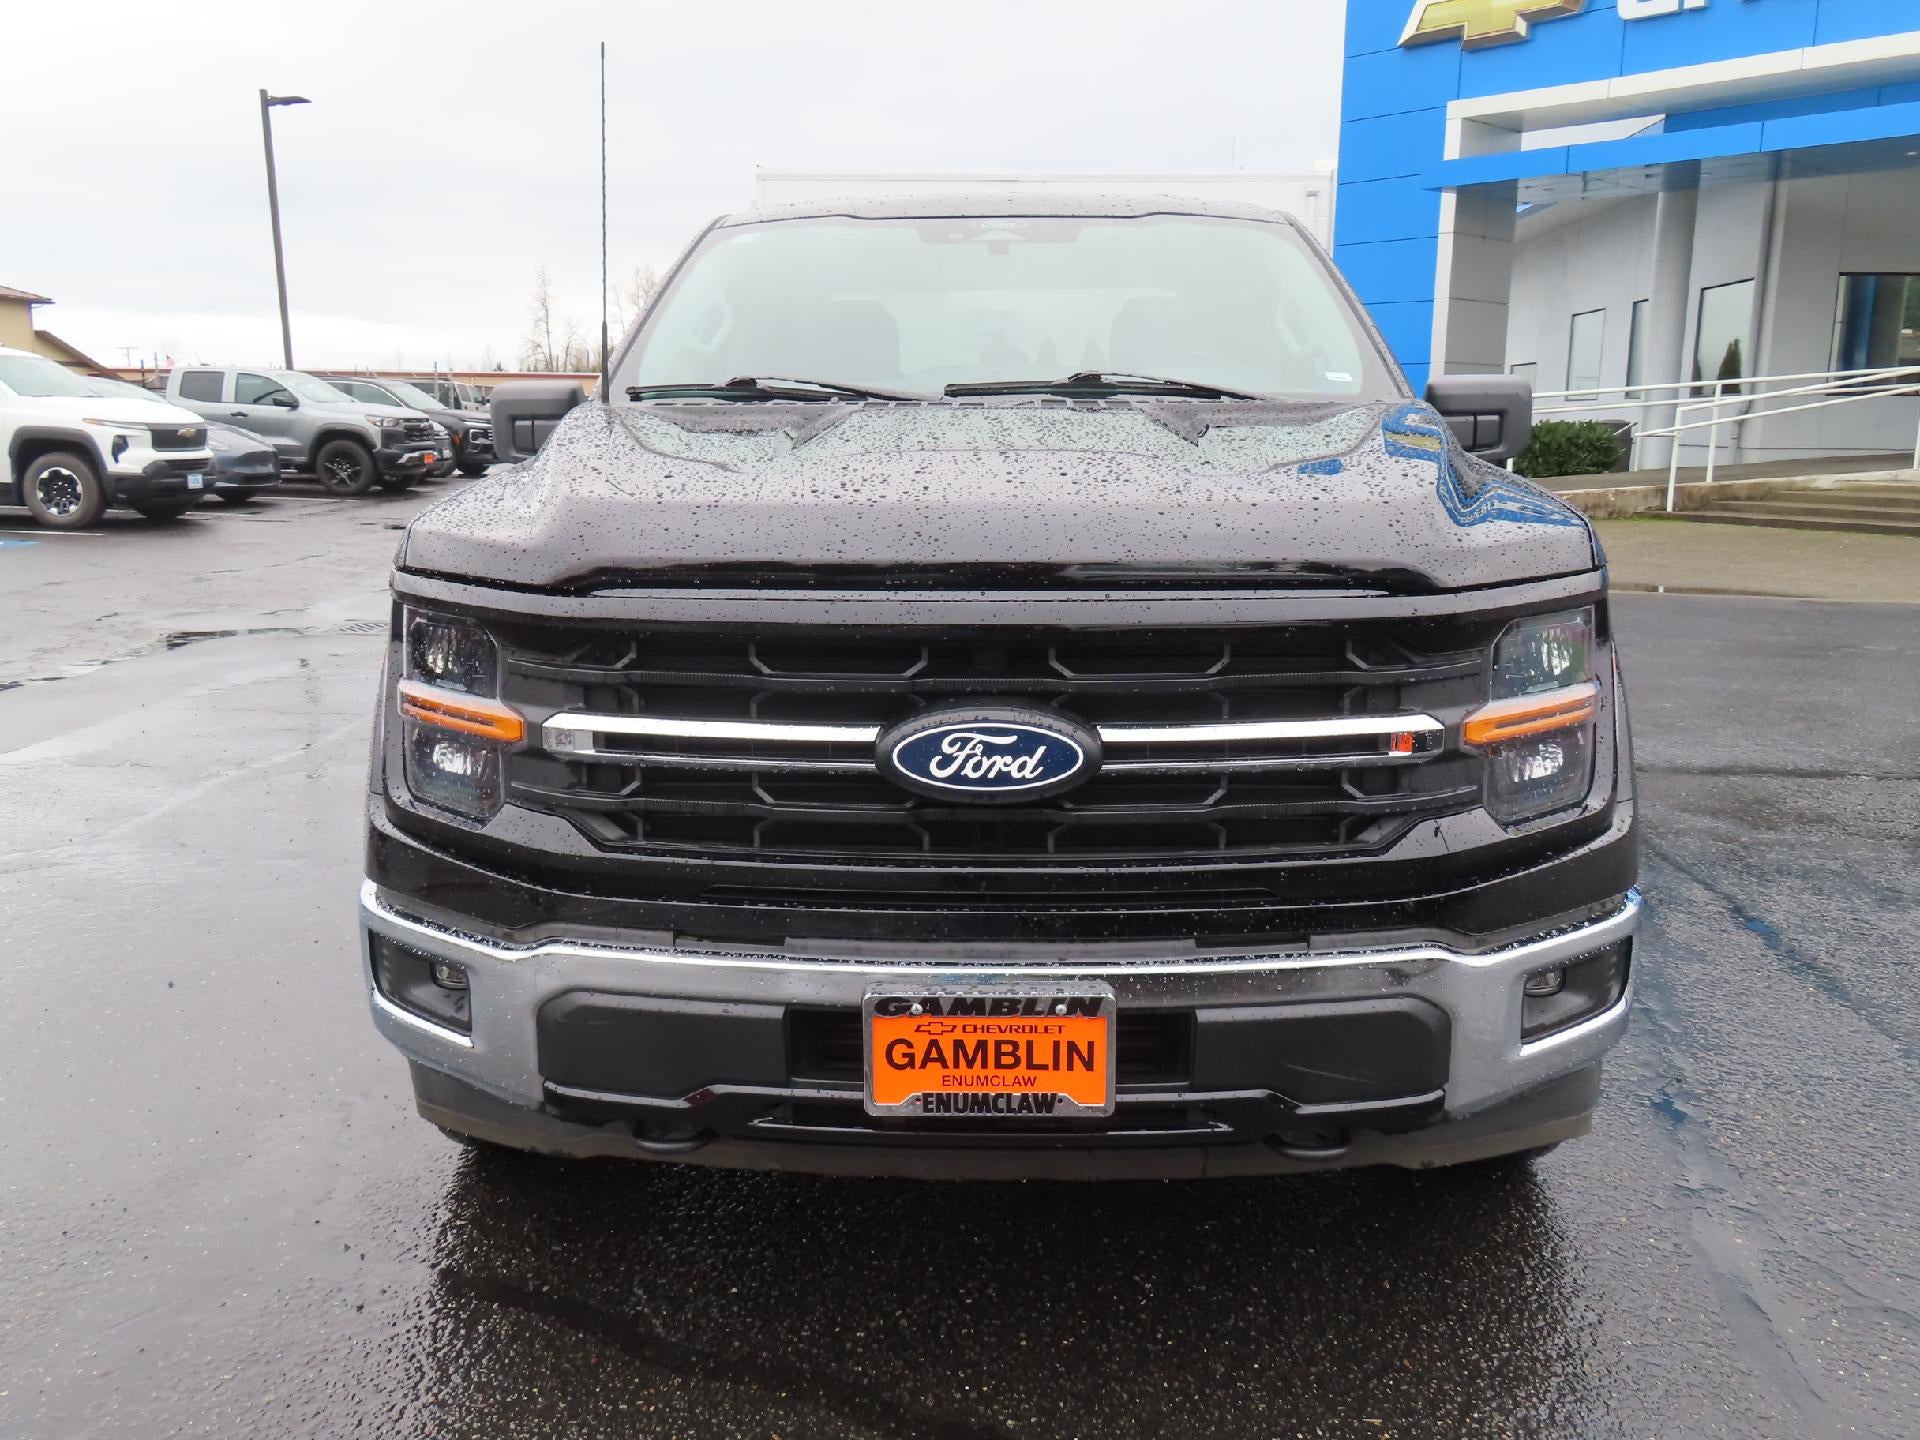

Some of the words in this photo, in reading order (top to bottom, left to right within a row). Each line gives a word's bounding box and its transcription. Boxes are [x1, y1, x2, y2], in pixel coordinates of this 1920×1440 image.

[929, 732, 1047, 779] Ford
[874, 996, 1103, 1017] GAMBLIN
[962, 1024, 1066, 1034] CHEVROLET
[885, 1038, 1095, 1072] GAMBLIN
[942, 1075, 1037, 1087] ENUMCLAW
[922, 1092, 1057, 1114] ENUMCLAW
